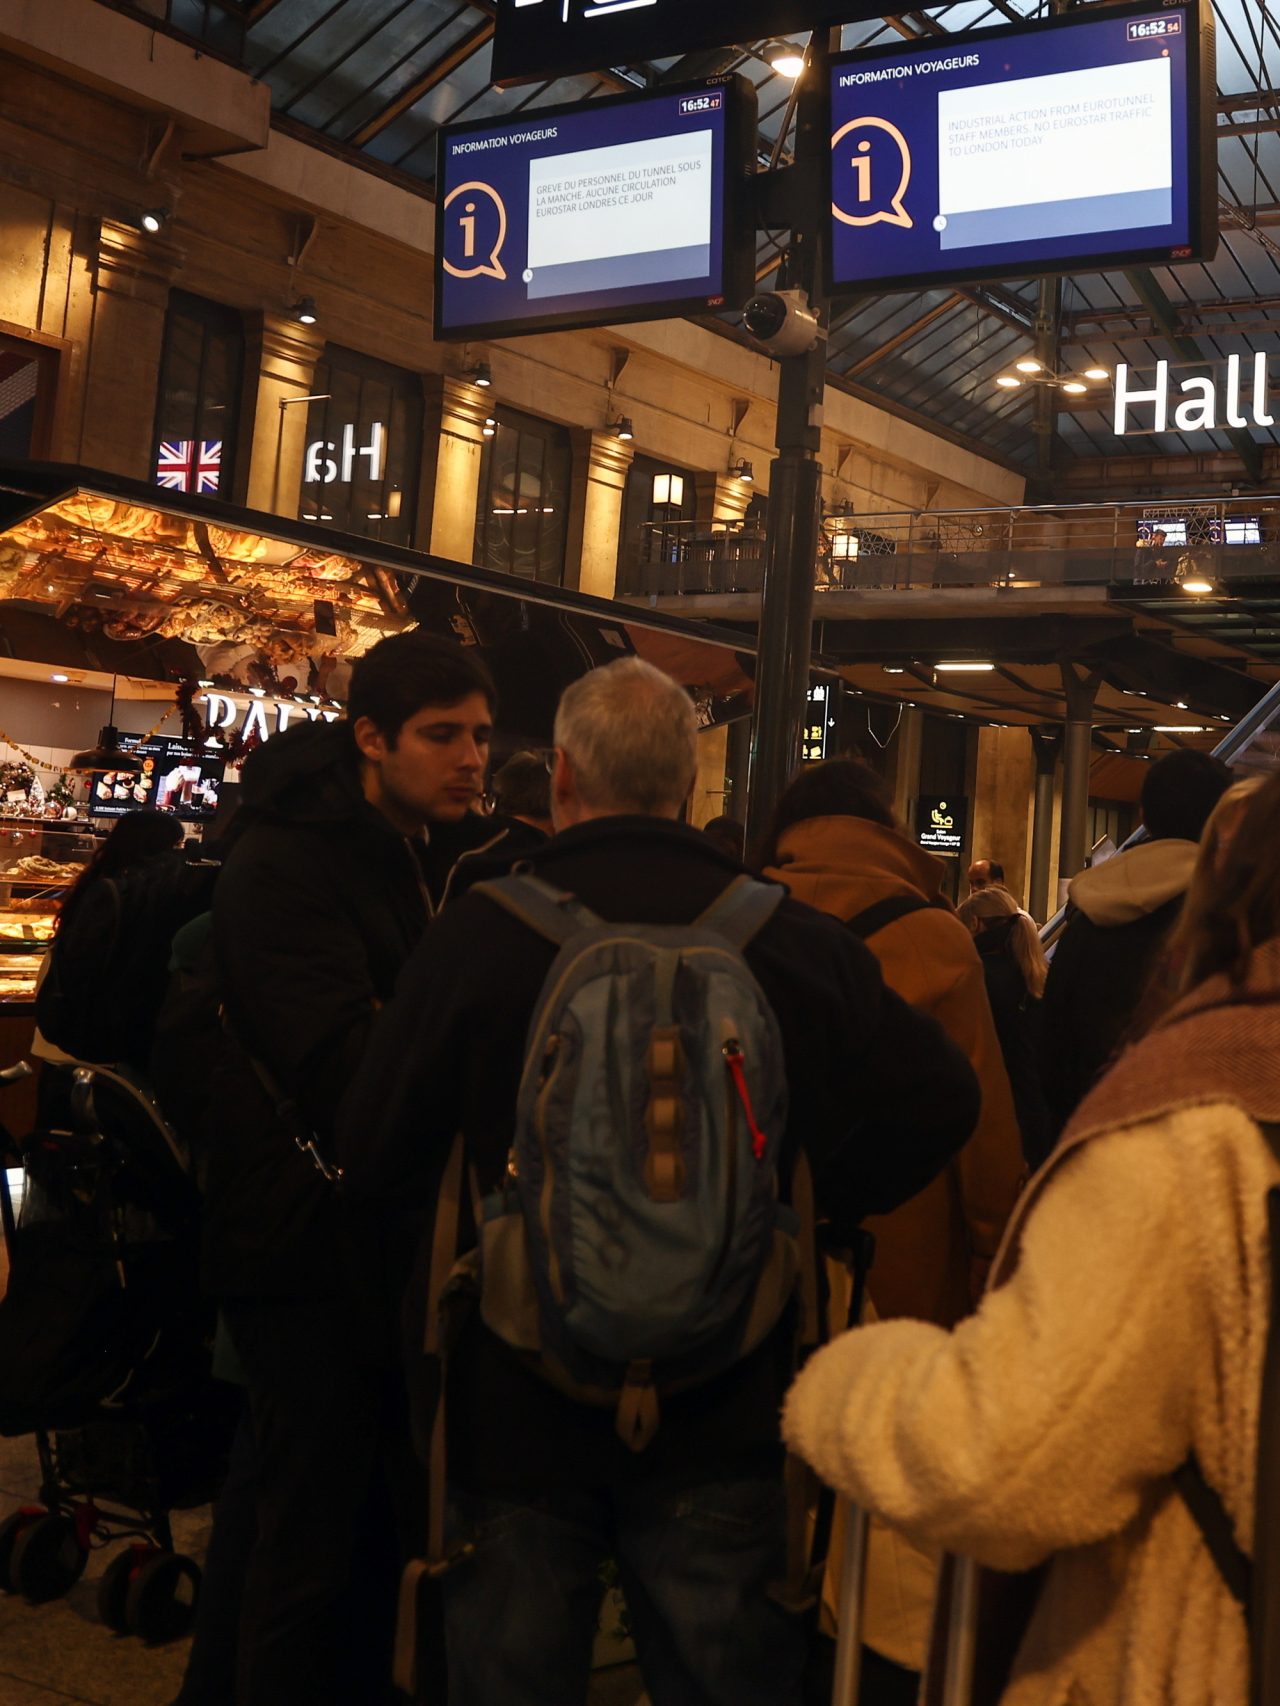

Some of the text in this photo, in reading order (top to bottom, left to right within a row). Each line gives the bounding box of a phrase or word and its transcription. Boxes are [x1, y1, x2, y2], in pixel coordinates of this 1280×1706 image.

[1130, 21, 1179, 37] 16:52 54
[839, 54, 980, 87] INFORMATION VOYAGEURS
[681, 97, 720, 112] 16:52 47
[949, 93, 1156, 131] INDUSTRIAL ACTION FROM EUROTUNNEL
[949, 131, 977, 144] STAFF
[1034, 121, 1050, 132] NO
[1053, 114, 1107, 130] EUROSTAR
[1109, 106, 1152, 121] TRAFFIC
[452, 127, 558, 155] INFORMATION VOYAGEURS
[949, 135, 1044, 157] TO LONDON TODAY
[536, 160, 702, 195] GREVE DU PERSONNEL DU TUNNEL SOUS
[536, 196, 547, 206] LA
[586, 185, 619, 198] AUCUNE
[621, 177, 676, 193] CIRCULATION
[536, 191, 654, 218] EUROSTAR LONDRES CE JOUR
[1114, 352, 1274, 436] Hall
